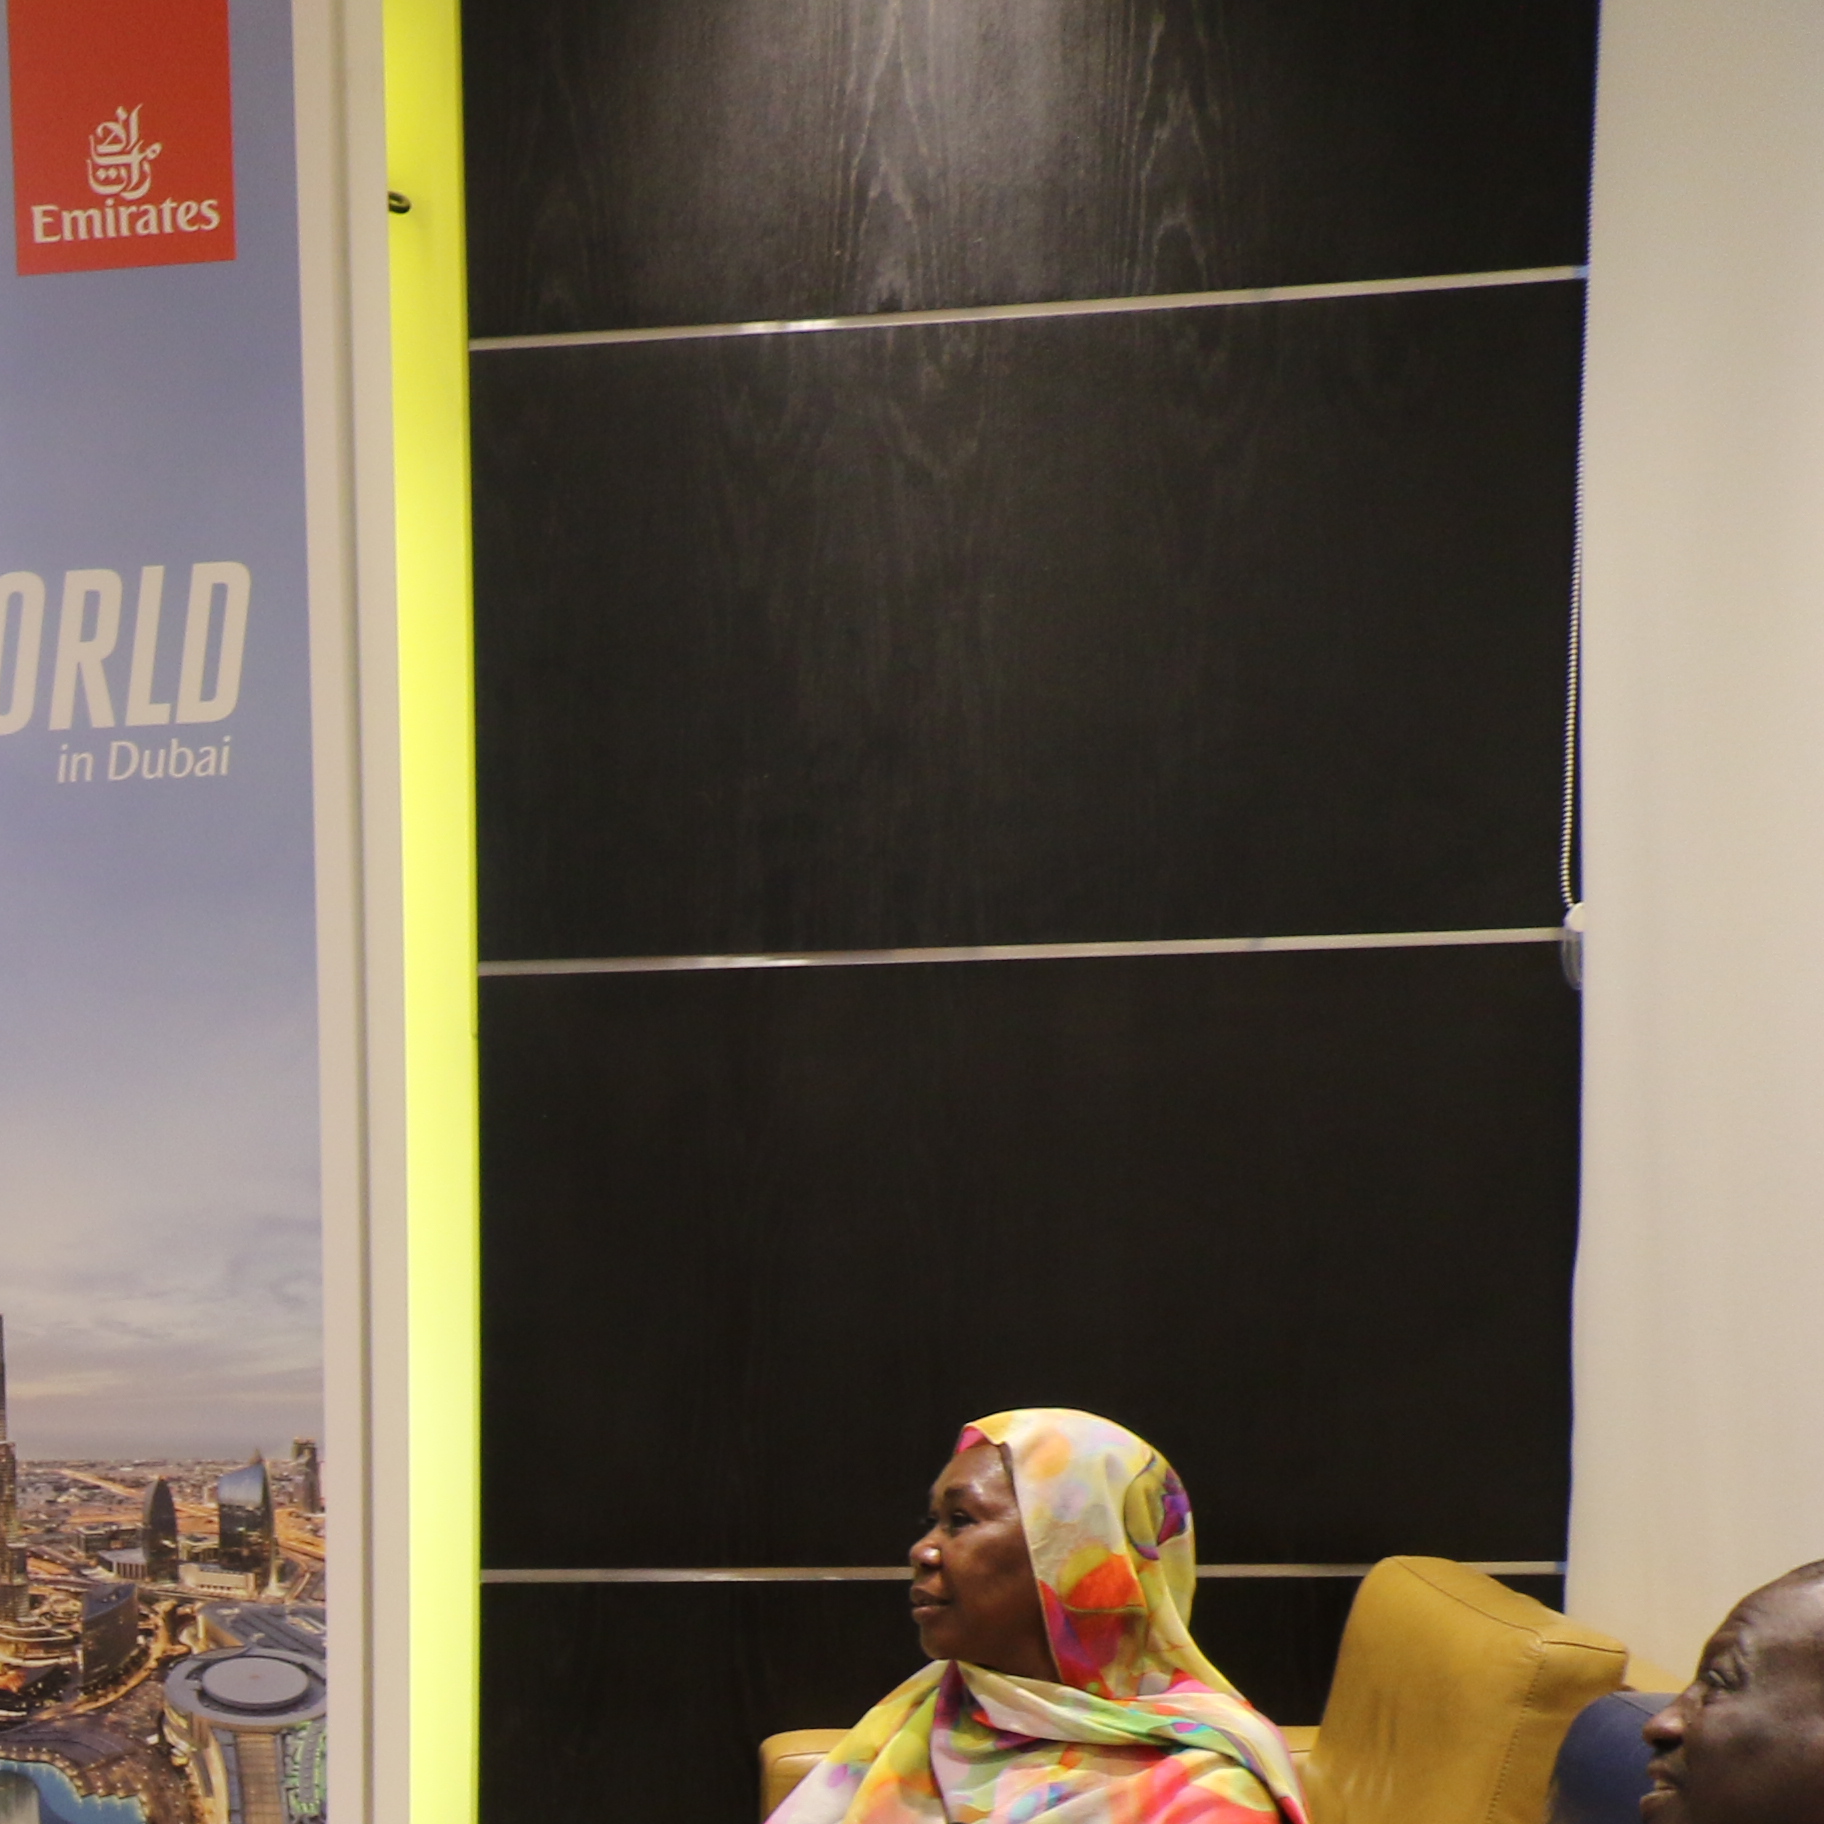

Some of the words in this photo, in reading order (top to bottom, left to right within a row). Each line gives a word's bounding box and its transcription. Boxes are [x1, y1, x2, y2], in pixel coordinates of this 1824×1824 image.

[31, 197, 221, 243] Emirates
[57, 743, 93, 784] in
[107, 735, 231, 781] Dubai
